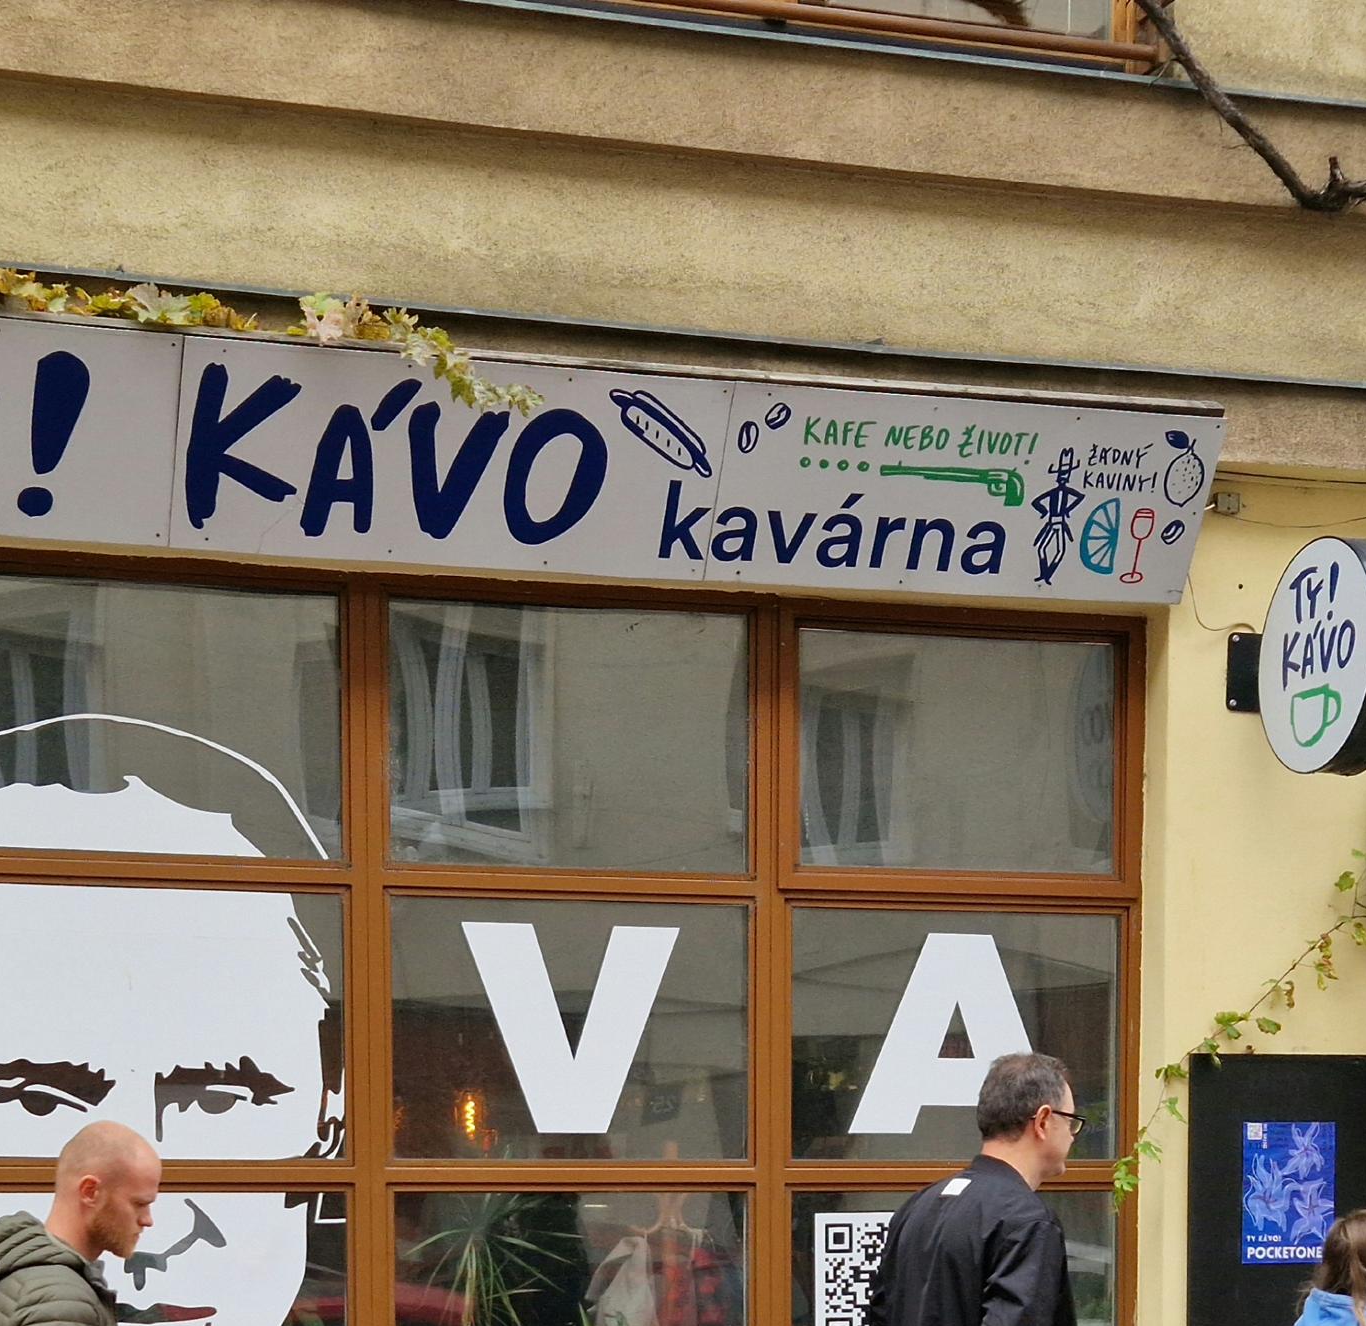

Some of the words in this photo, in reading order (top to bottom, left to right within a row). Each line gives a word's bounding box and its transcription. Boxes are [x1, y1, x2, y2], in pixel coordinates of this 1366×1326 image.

[185, 361, 609, 546] KÁVO
[804, 416, 877, 448] KAFE
[885, 424, 950, 451] NEBO
[957, 423, 1039, 466] ŽIVOT!
[1083, 470, 1158, 493] KAVINY!
[658, 478, 1007, 576] kavárna
[1289, 561, 1340, 624] TY!
[1282, 618, 1356, 691] KÁVO
